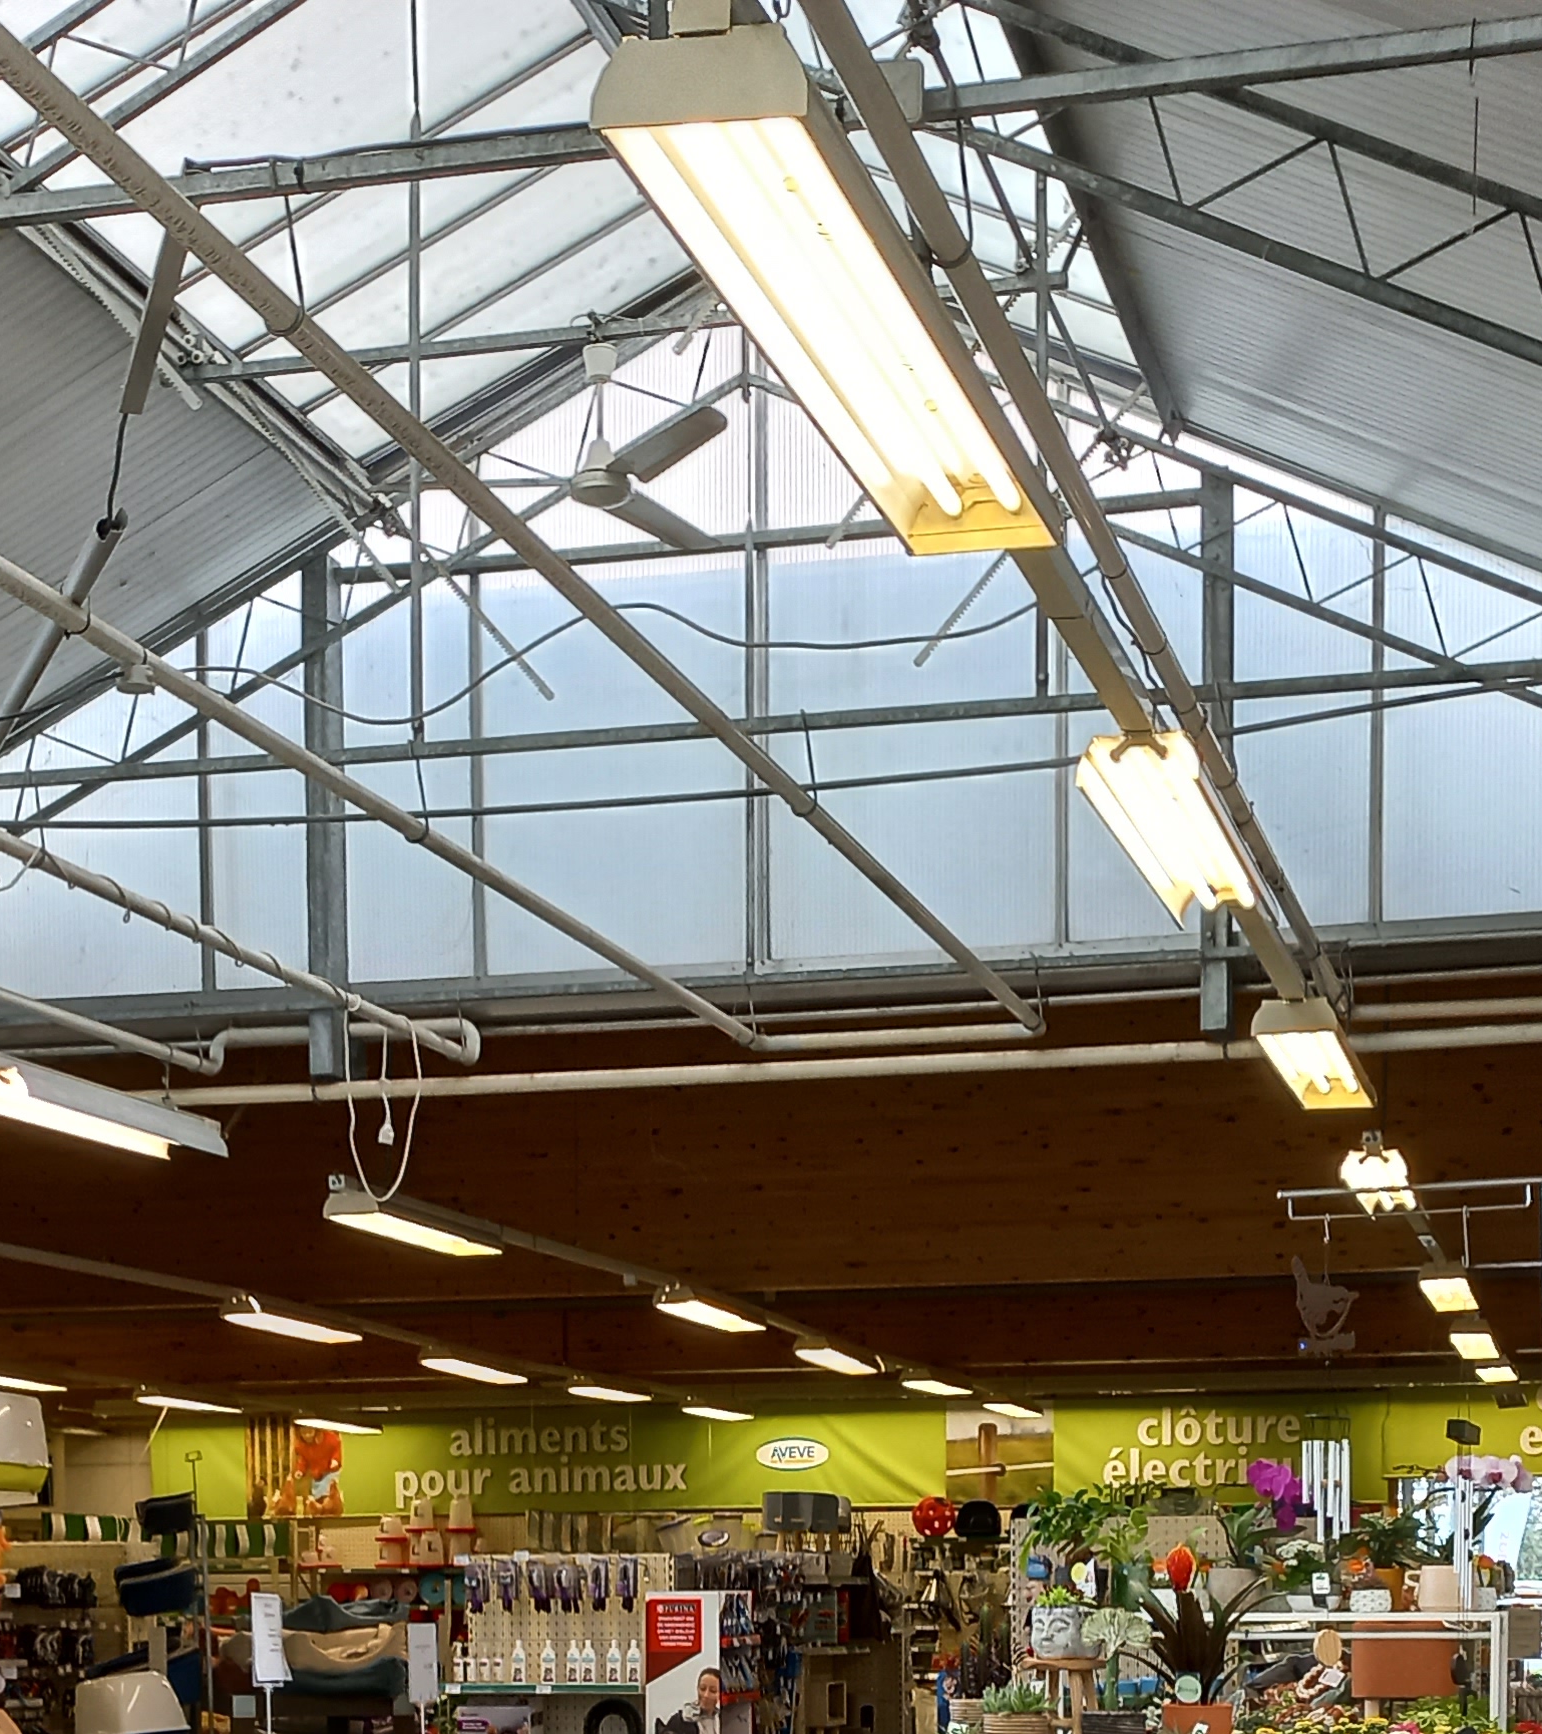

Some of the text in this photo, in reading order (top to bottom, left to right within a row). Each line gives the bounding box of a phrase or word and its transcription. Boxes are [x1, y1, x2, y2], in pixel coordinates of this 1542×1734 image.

[448, 1417, 629, 1457] aliments
[1137, 1406, 1301, 1446] clôture
[770, 1445, 816, 1463] AVEVE
[1103, 1446, 1295, 1488] électri
[395, 1457, 688, 1509] pour animaux
